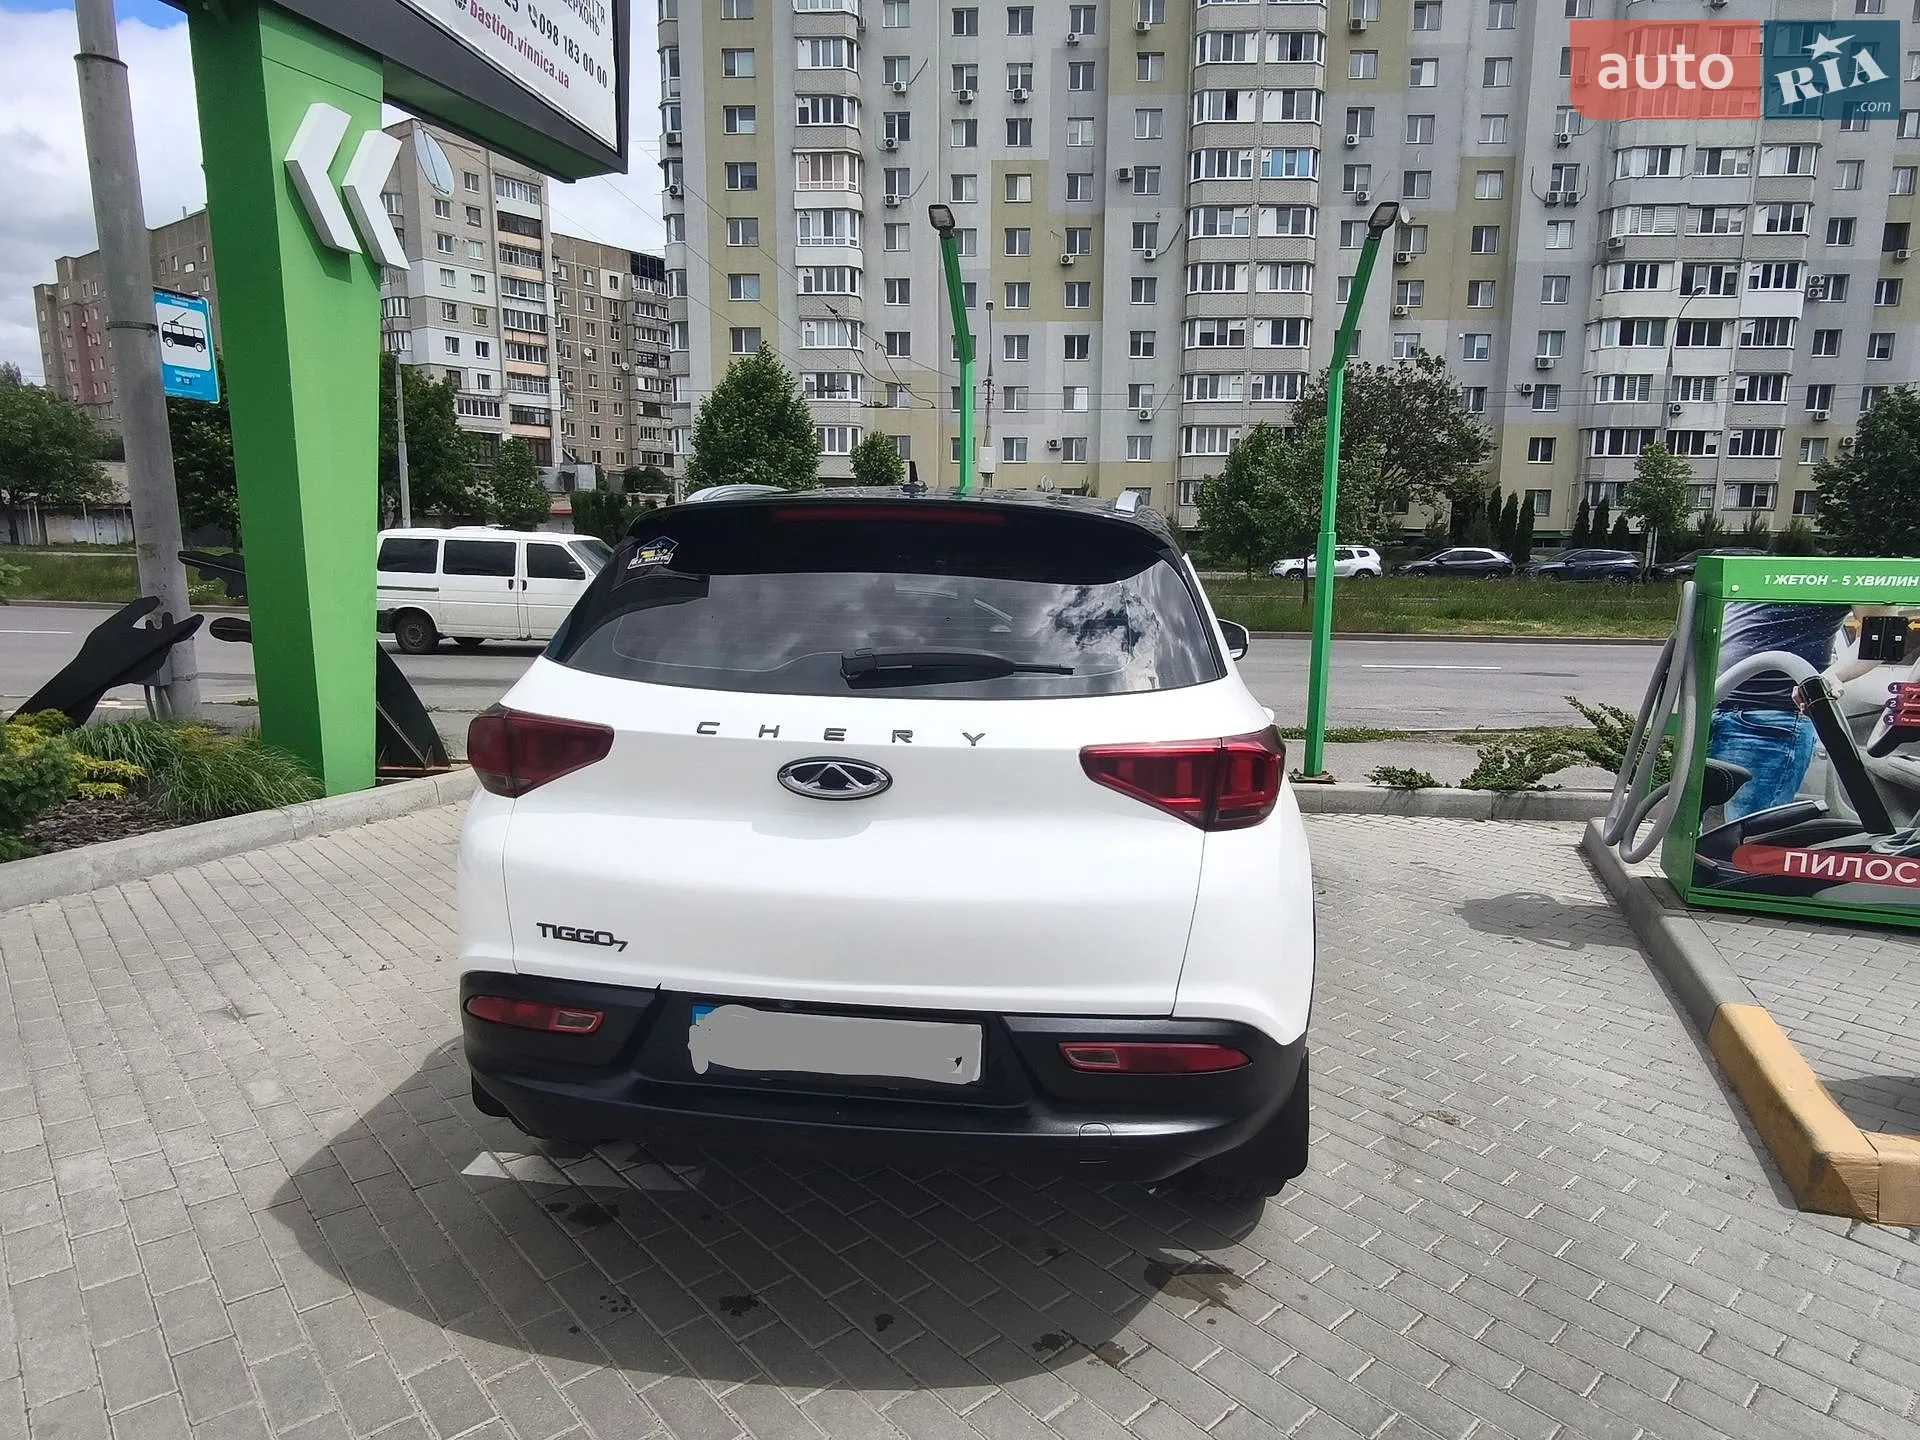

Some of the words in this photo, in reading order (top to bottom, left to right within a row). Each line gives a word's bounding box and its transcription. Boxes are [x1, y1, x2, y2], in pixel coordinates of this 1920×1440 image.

[562, 0, 600, 36] ЕРХОНЬ
[470, 0, 569, 89] bastion.vinnica.ua
[540, 14, 558, 46] 098
[563, 36, 580, 64] 183
[583, 53, 594, 77] 00
[597, 66, 608, 89] 00
[1764, 575, 1772, 585] 1
[1773, 575, 1828, 586] ЖЕТОН
[1841, 575, 1851, 586] 5
[1854, 575, 1920, 587] ХВИЛИН
[696, 721, 986, 747] CHERY
[1783, 851, 1920, 884] ПИЛОС
